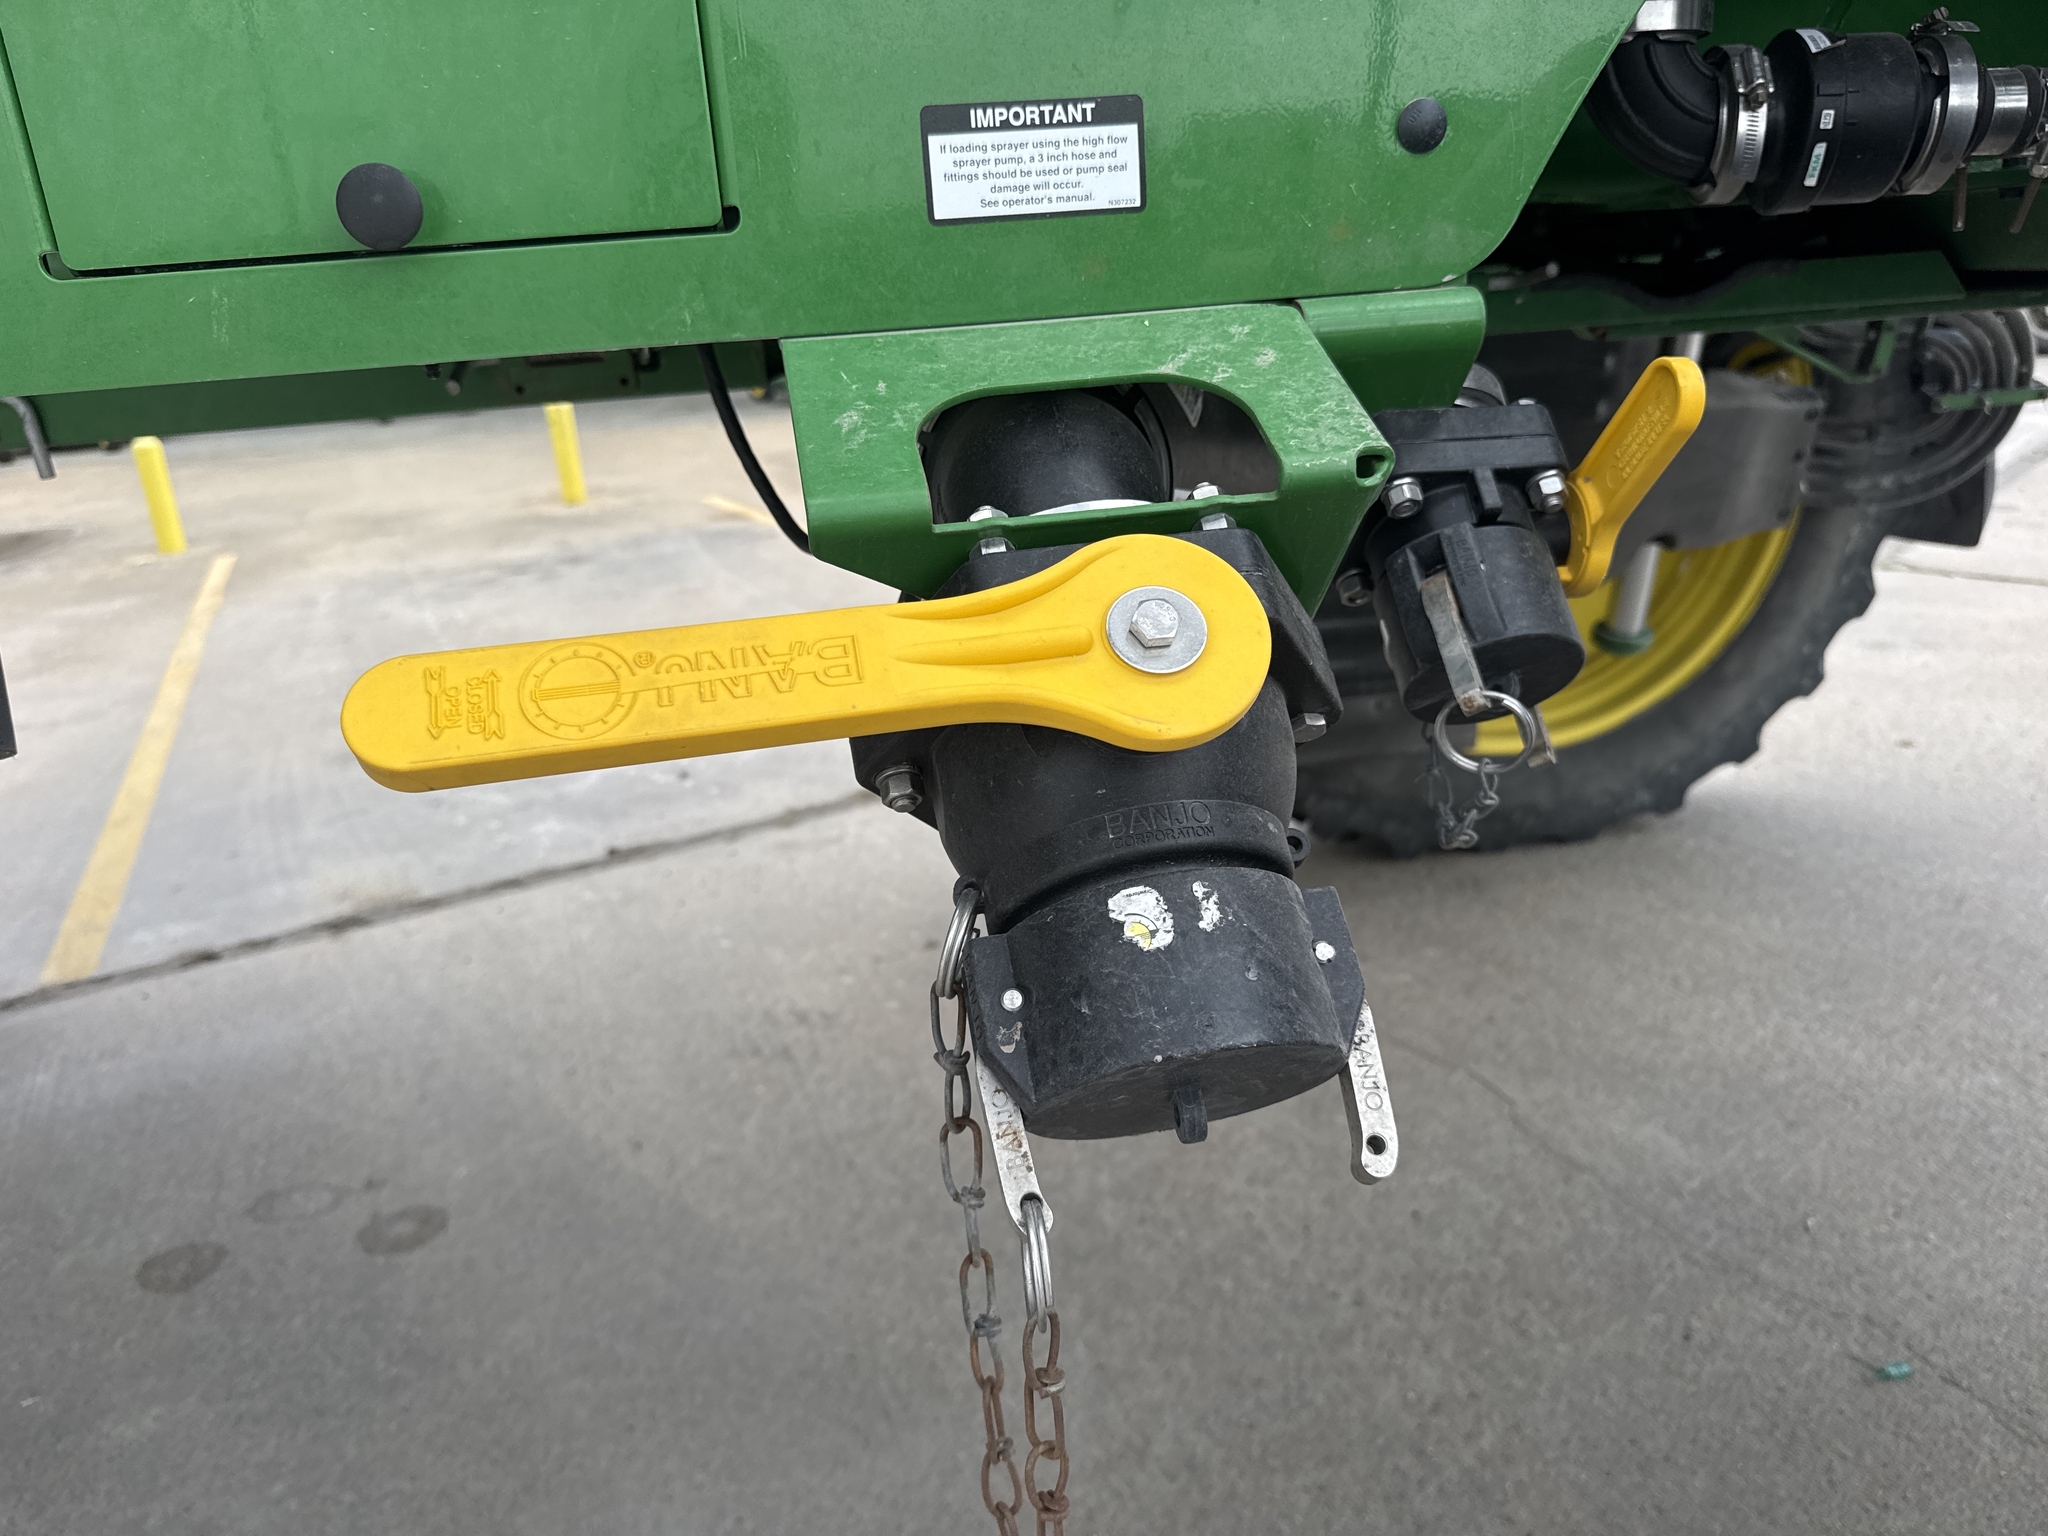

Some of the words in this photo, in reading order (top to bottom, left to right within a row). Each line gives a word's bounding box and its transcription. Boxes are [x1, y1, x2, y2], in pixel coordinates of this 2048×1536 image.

[969, 102, 1096, 128] IMPORTANT
[939, 144, 947, 154] If
[949, 143, 988, 155] loading
[990, 141, 1029, 153] sprayer
[1032, 139, 1061, 151] using
[1063, 137, 1079, 147] the
[1081, 136, 1104, 149] high
[1107, 135, 1128, 145] flow
[952, 157, 992, 169] sprayer
[994, 155, 1027, 167] pump,
[1029, 156, 1035, 164] a
[1037, 154, 1044, 163] 3
[1046, 152, 1069, 163] inch
[1071, 150, 1096, 161] hose
[1098, 149, 1118, 159] and
[943, 171, 980, 184] fittings
[982, 169, 1017, 180] should
[1019, 168, 1033, 178] be
[1035, 166, 1060, 177] used
[1062, 167, 1073, 176] or
[1076, 165, 1105, 176] pump
[1107, 162, 1128, 173] seal
[990, 184, 1031, 195] damage
[1033, 181, 1050, 191] will
[1053, 181, 1084, 190] occur.
[980, 198, 999, 209] See
[1002, 195, 1053, 208] operator's
[1056, 193, 1096, 204] manual.
[1108, 198, 1137, 206] N307232
[444, 686, 463, 729] OPEN
[465, 676, 485, 735] CLOSED
[1104, 800, 1212, 839] BANJO
[1112, 825, 1216, 849] CORPORATION
[1352, 1033, 1384, 1111] BANJO
[990, 1087, 1026, 1171] BANJO
